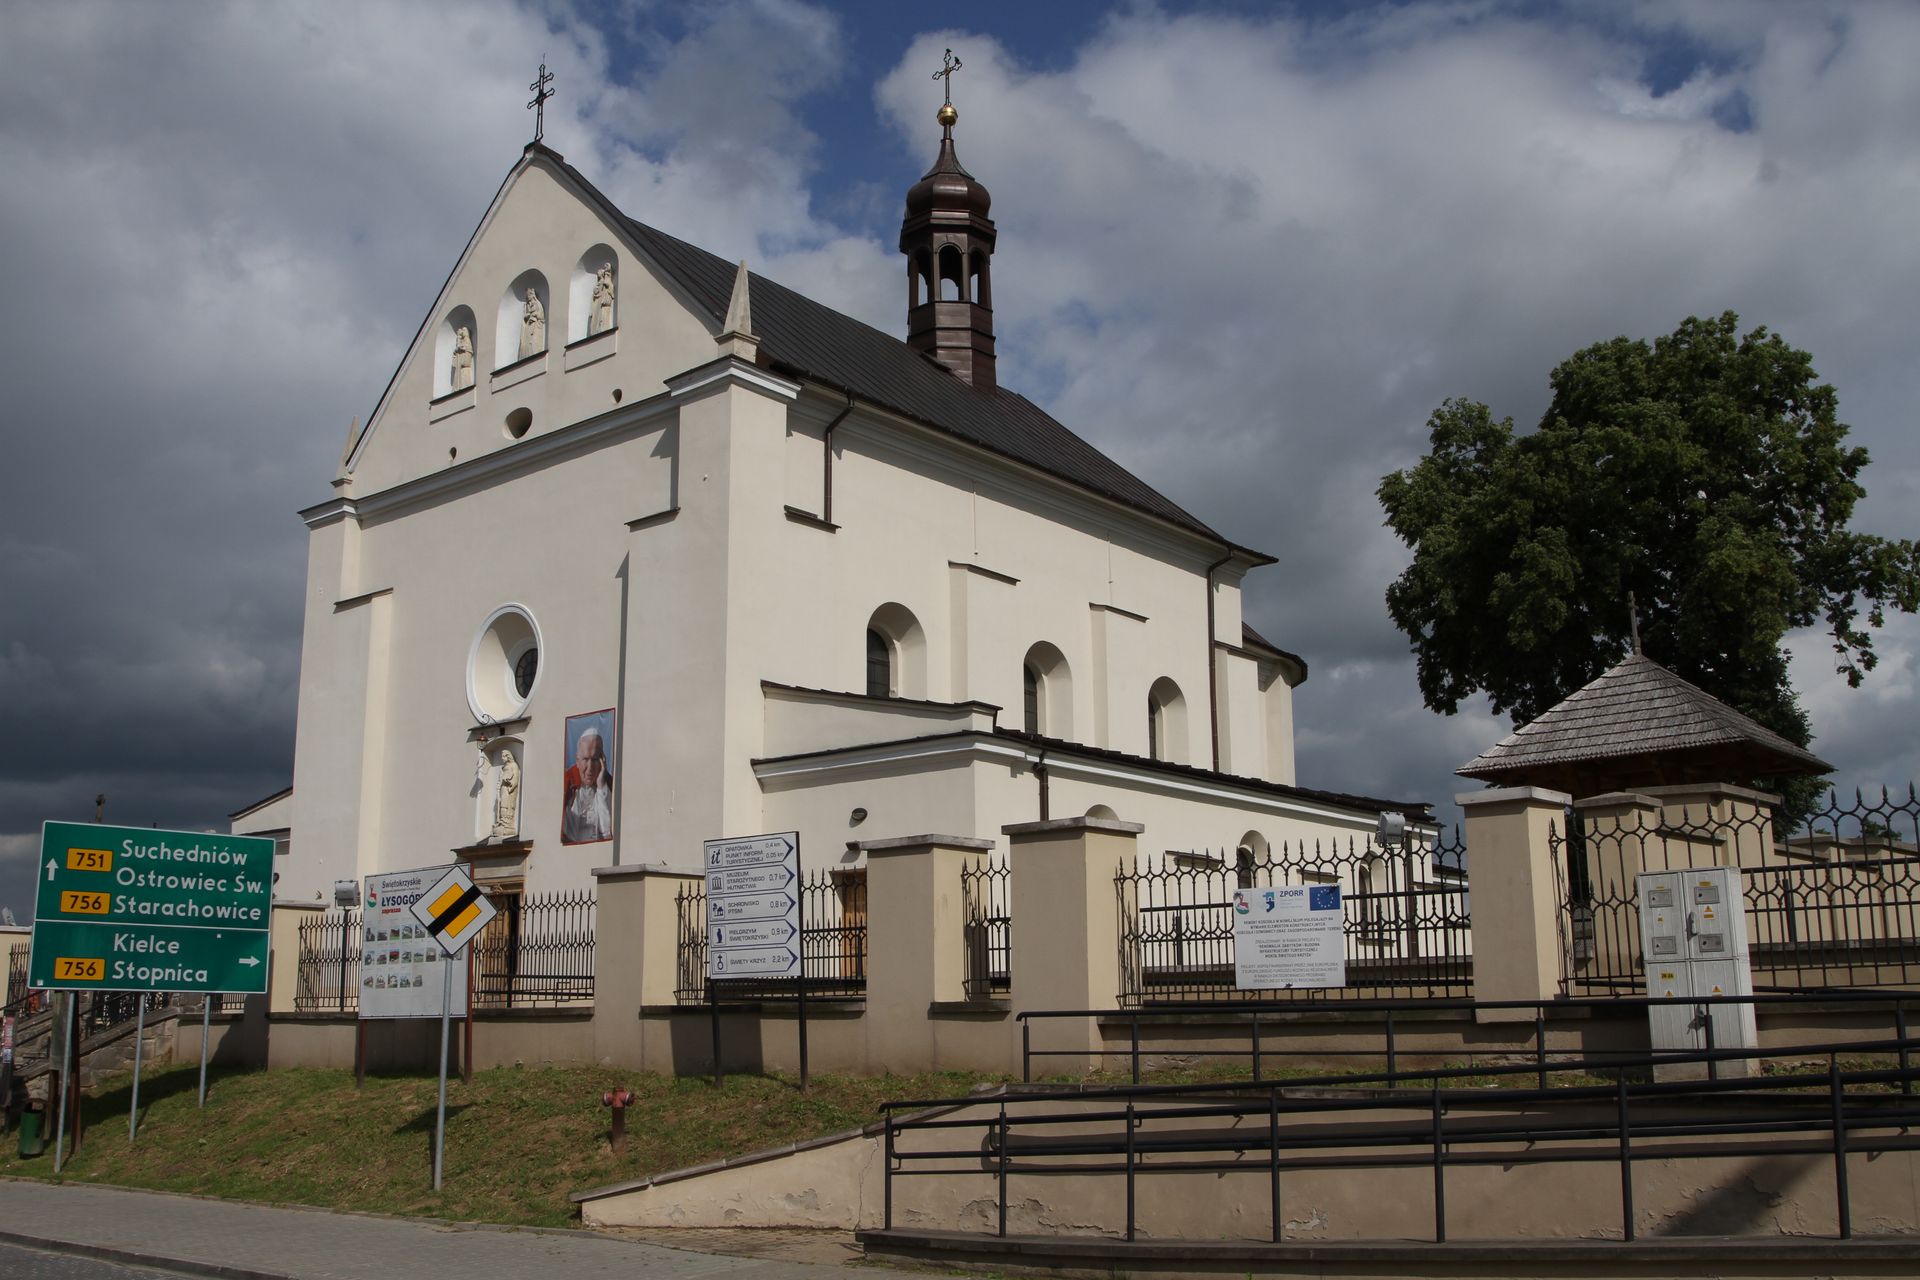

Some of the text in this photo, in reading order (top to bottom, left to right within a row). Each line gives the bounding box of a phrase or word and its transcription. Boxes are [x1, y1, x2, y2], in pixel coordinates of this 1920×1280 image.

[76, 852, 104, 868] 751
[120, 839, 248, 866] Suchedniów
[116, 867, 264, 894] Ostrowiec Św.
[381, 892, 423, 907] ŁYSOGÓR
[1279, 889, 1304, 898] ZPORR
[69, 895, 262, 921] 756 Starachowice
[113, 933, 180, 954] Kielce
[63, 960, 208, 986] 756 Stopnica
